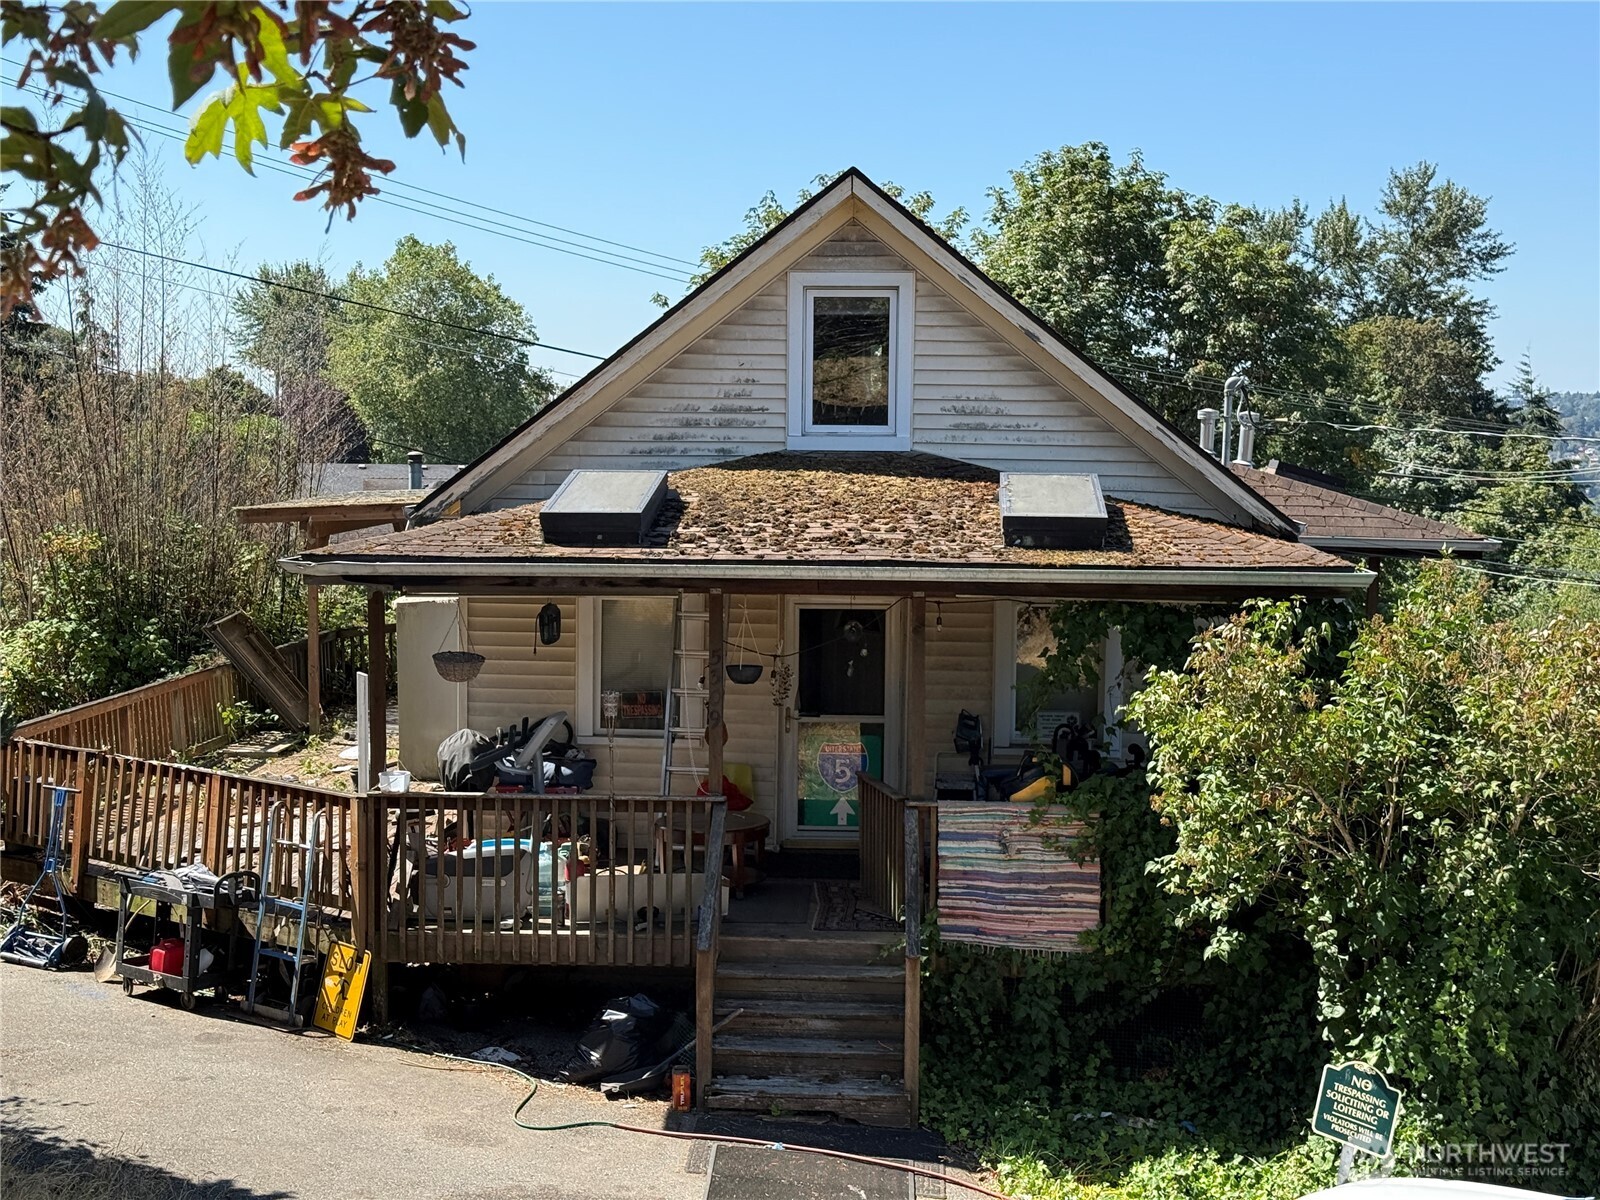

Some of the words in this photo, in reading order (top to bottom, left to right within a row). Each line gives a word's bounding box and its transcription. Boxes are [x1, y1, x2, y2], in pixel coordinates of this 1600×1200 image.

[637, 692, 647, 704] NO
[622, 704, 663, 717] TRESPASSING
[835, 759, 851, 783] 5
[321, 1013, 330, 1022] AT
[332, 1016, 348, 1029] PLAY
[1351, 1074, 1373, 1091] NO
[1325, 1089, 1374, 1114] SOLICITING
[1375, 1108, 1390, 1120] OR
[1333, 1081, 1387, 1109] TRESPASSING
[1333, 1102, 1378, 1125] LOITERING
[1323, 1113, 1357, 1131] VIOLATORS
[1358, 1125, 1373, 1138] WILL
[1375, 1130, 1384, 1141] BE
[1330, 1123, 1372, 1144] PROSECUTED
